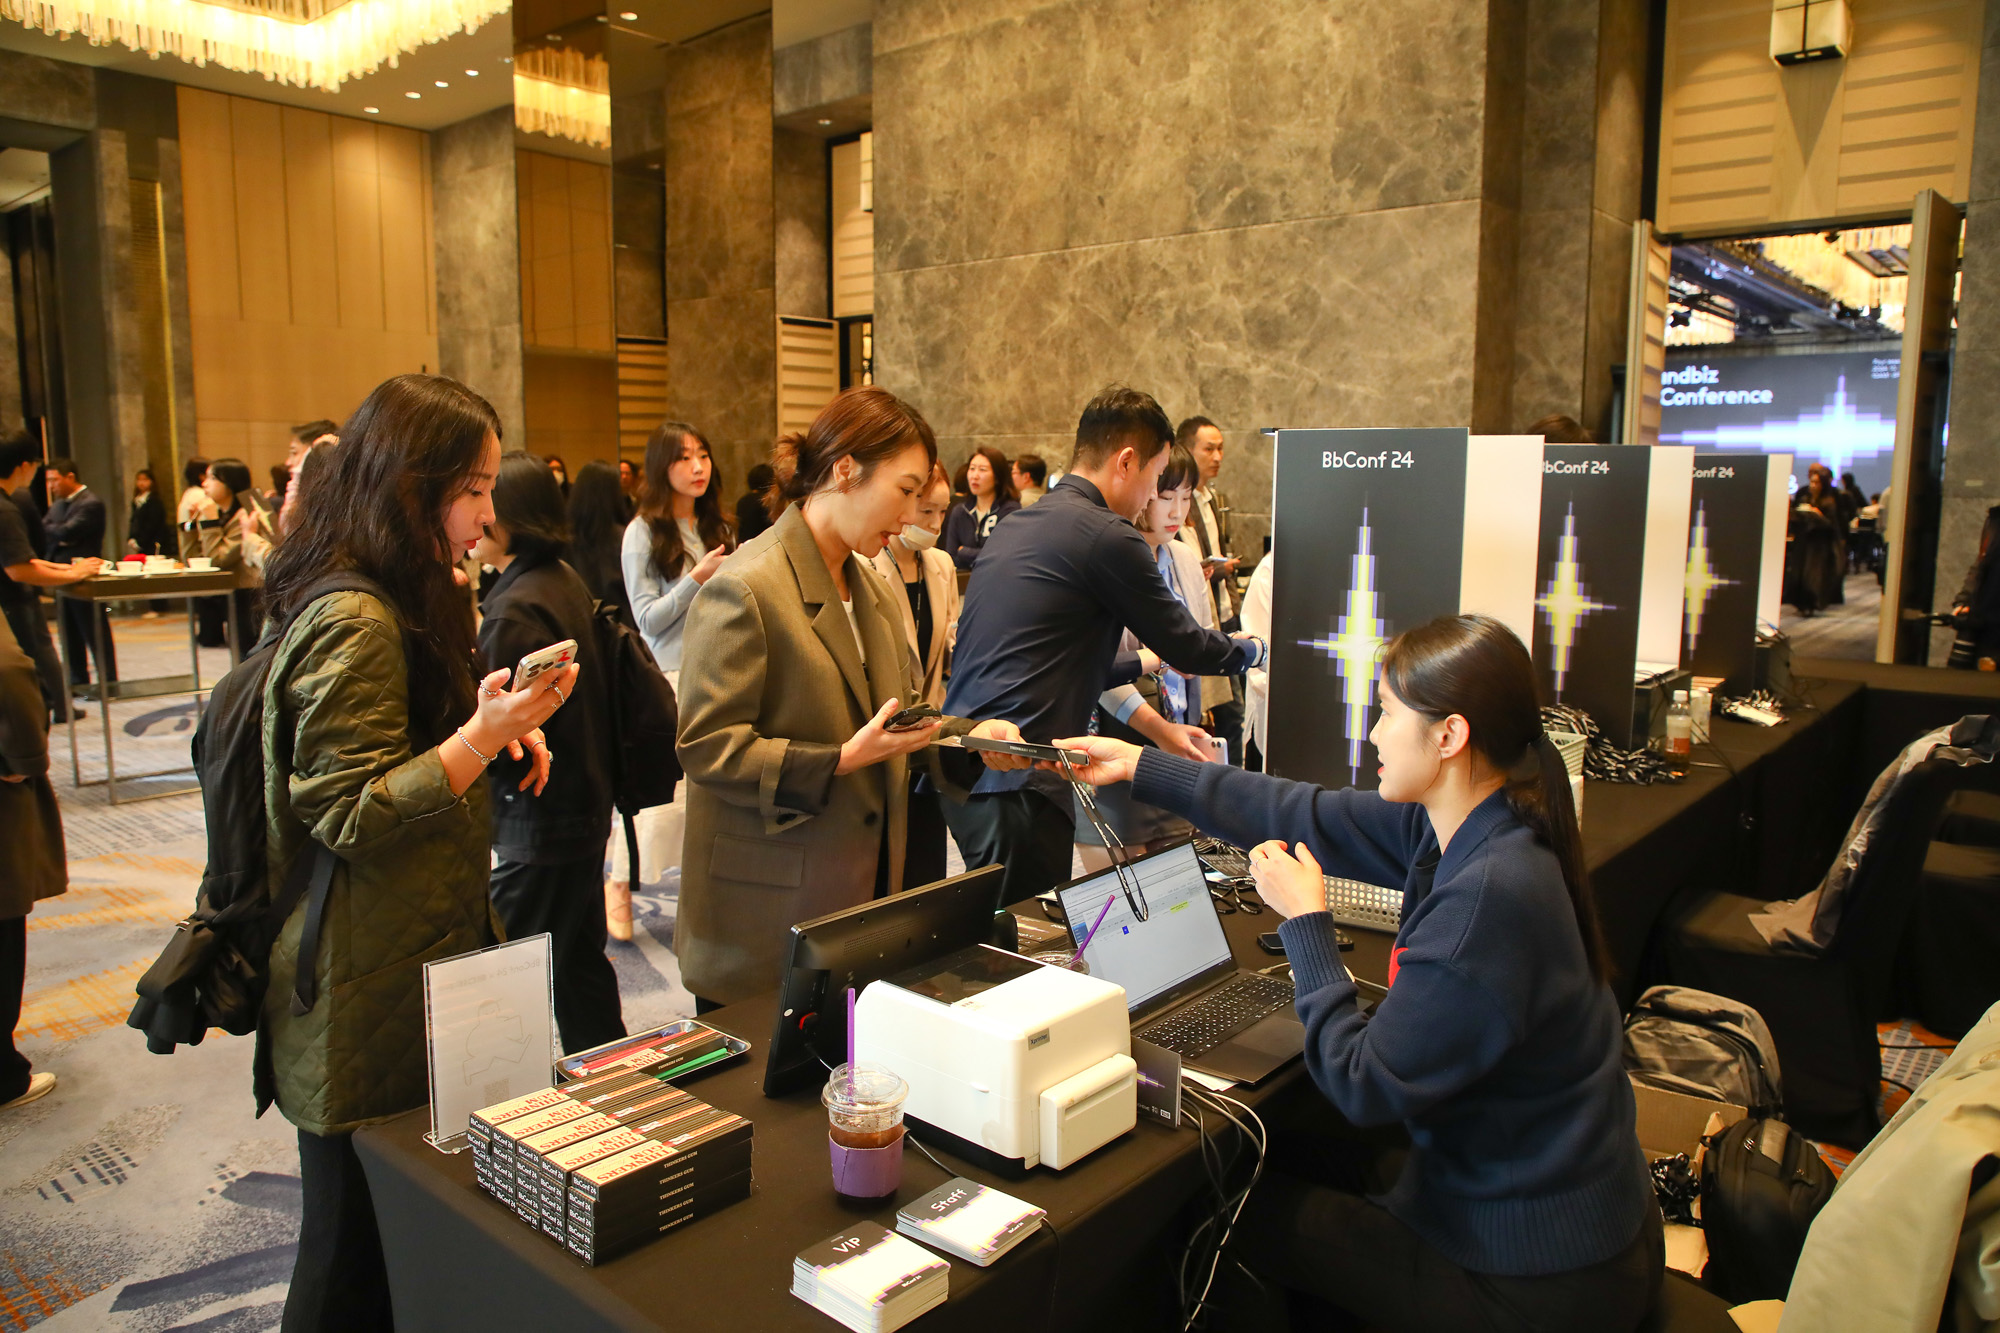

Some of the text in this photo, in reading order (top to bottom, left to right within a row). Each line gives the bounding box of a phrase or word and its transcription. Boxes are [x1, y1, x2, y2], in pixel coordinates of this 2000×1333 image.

[1660, 386, 1773, 406] Conference
[1322, 451, 1414, 468] BbConf 24
[1591, 460, 1610, 474] 24
[1718, 466, 1735, 478] 24
[525, 1091, 557, 1104] GUM
[491, 1096, 565, 1120] THINKERS
[548, 1103, 581, 1118] GUM
[514, 1108, 588, 1136] THINKERS
[574, 1116, 607, 1131] GUM
[540, 1120, 615, 1150] THINKERS
[600, 1132, 632, 1146] GUM
[565, 1136, 641, 1166] THINKERS
[630, 1145, 663, 1160] GUM
[597, 1150, 672, 1182] THINKERS
[930, 1188, 968, 1212] Staff
[832, 1237, 860, 1253] VIP
